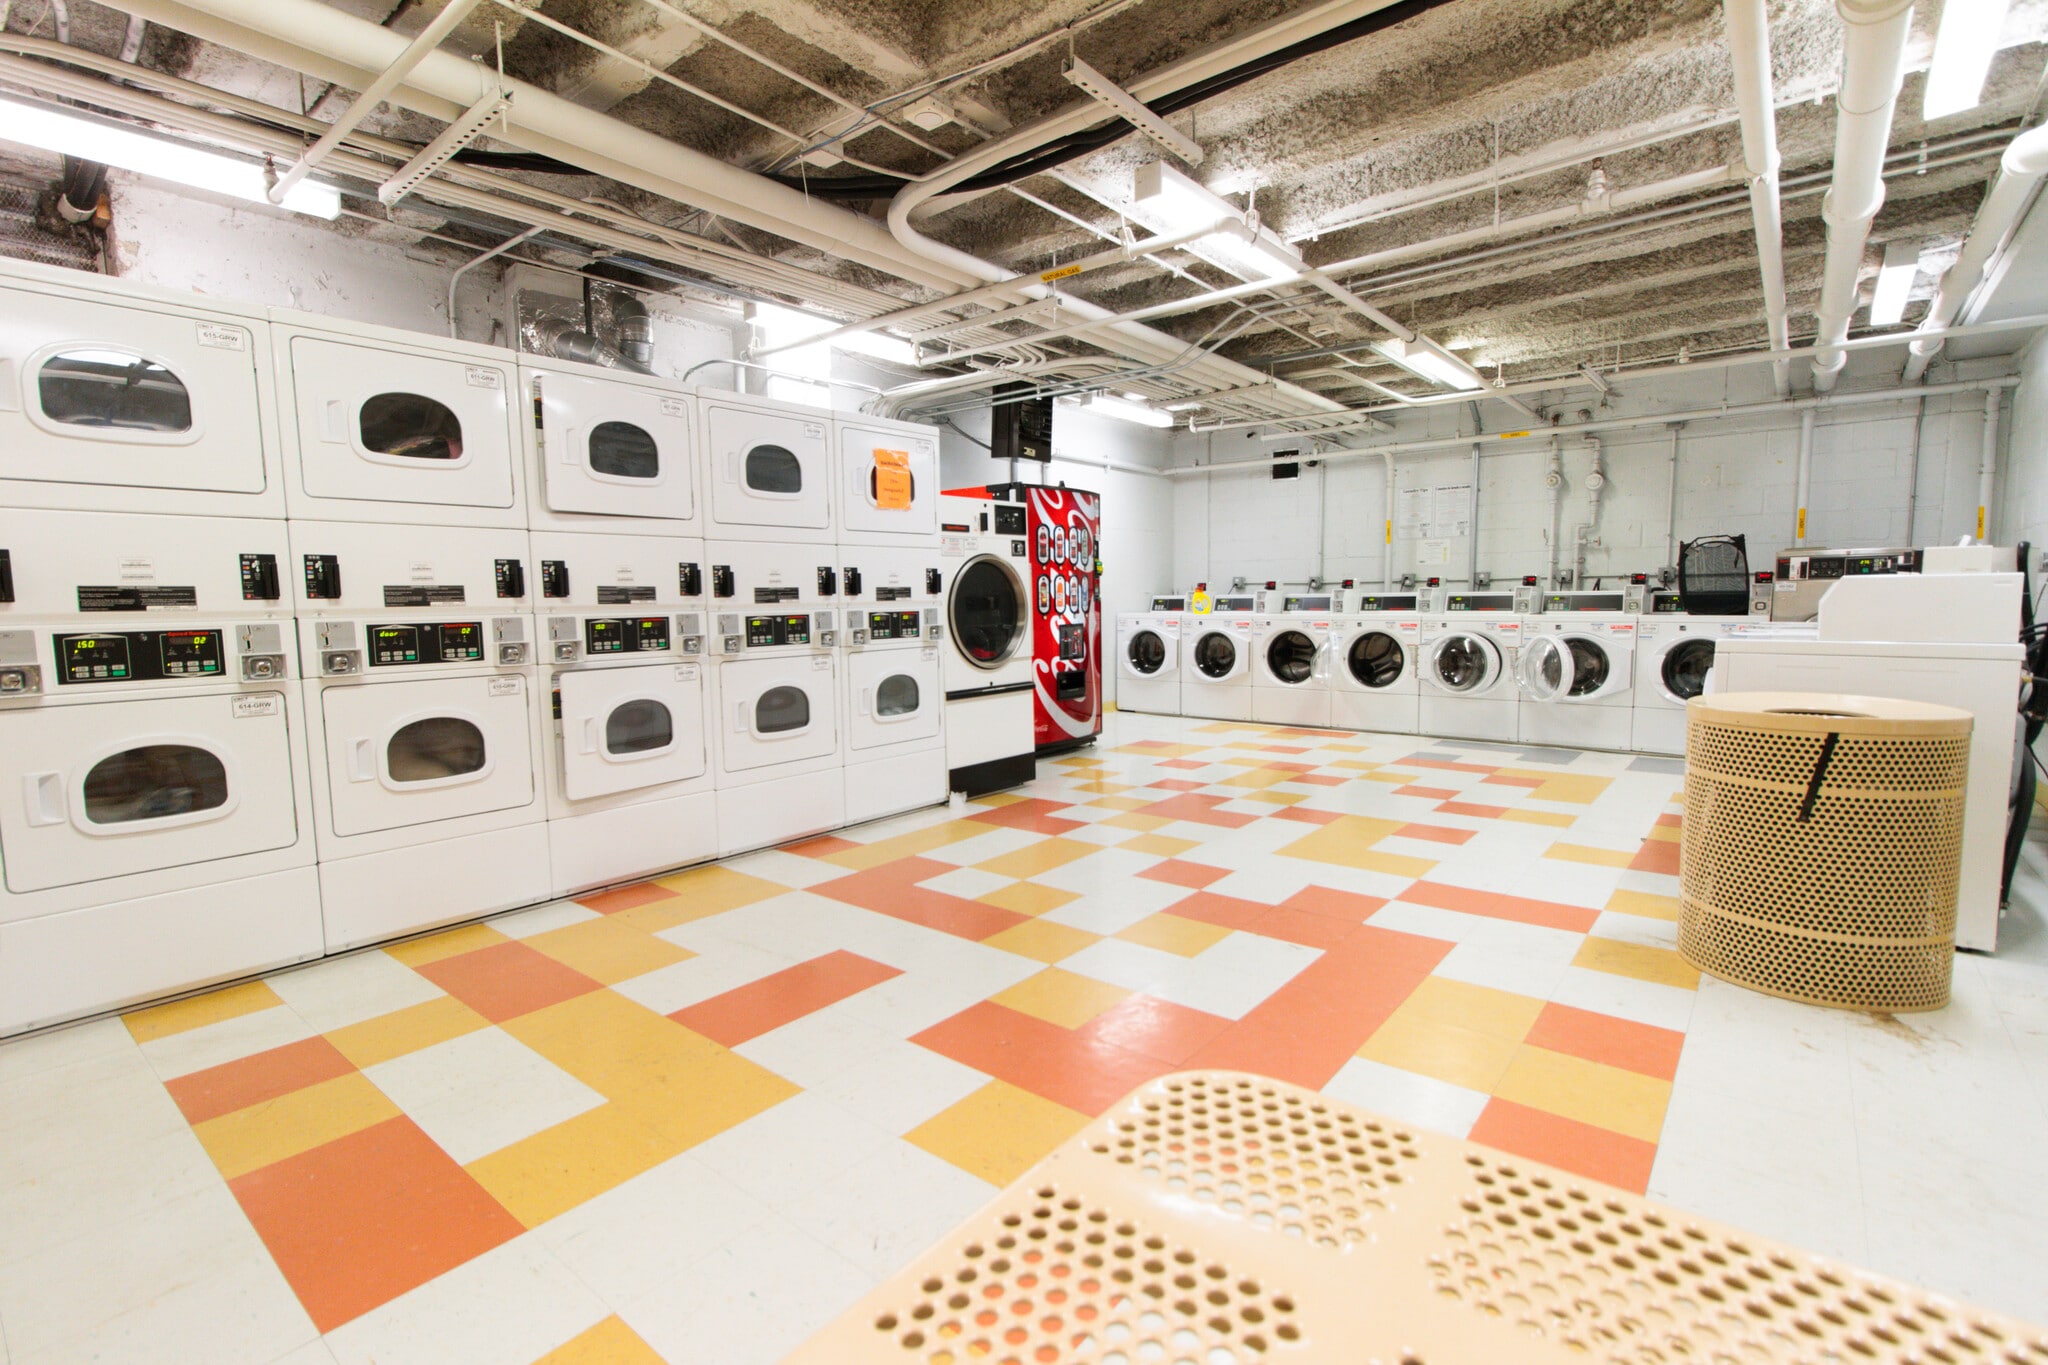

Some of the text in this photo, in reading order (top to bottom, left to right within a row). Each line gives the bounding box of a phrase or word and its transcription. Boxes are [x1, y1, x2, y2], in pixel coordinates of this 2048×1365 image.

[1042, 266, 1080, 281] NATURAL GAS
[203, 332, 238, 342] 615-GRW
